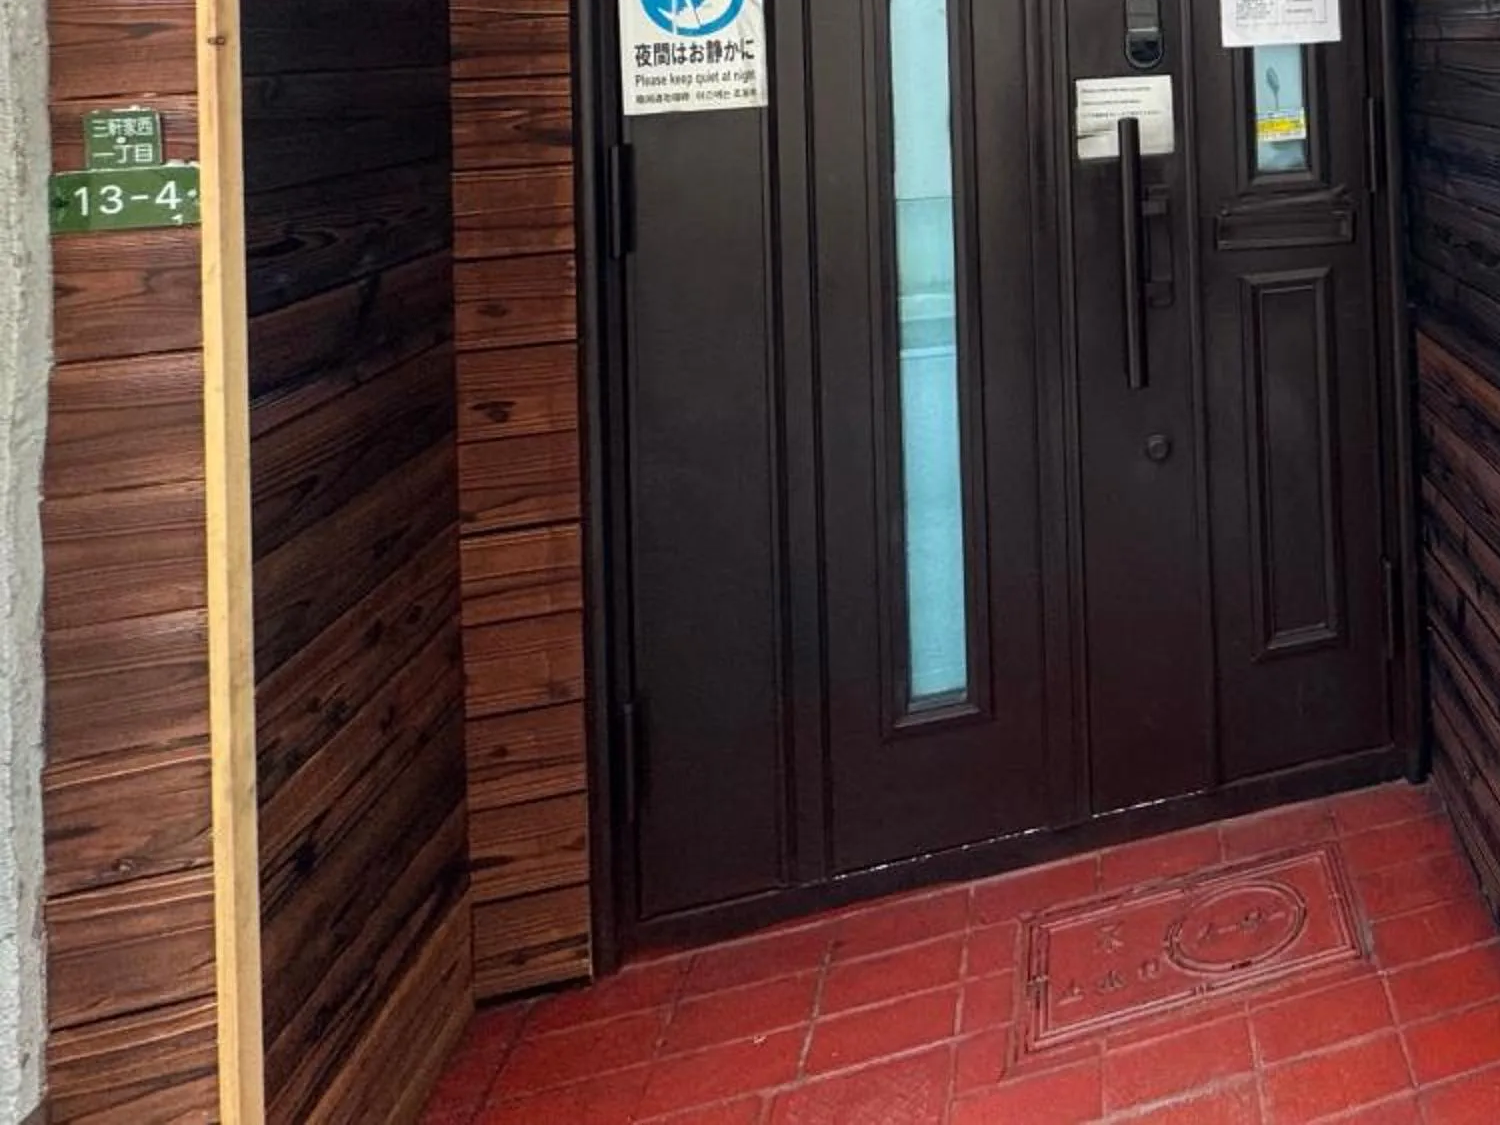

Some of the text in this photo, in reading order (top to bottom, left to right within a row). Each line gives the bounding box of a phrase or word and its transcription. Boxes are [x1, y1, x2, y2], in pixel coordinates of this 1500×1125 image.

[634, 39, 755, 68] 夜間はお静かに
[635, 74, 667, 87] Please
[669, 73, 693, 86] keep
[696, 70, 720, 86] quiet
[721, 71, 732, 82] at
